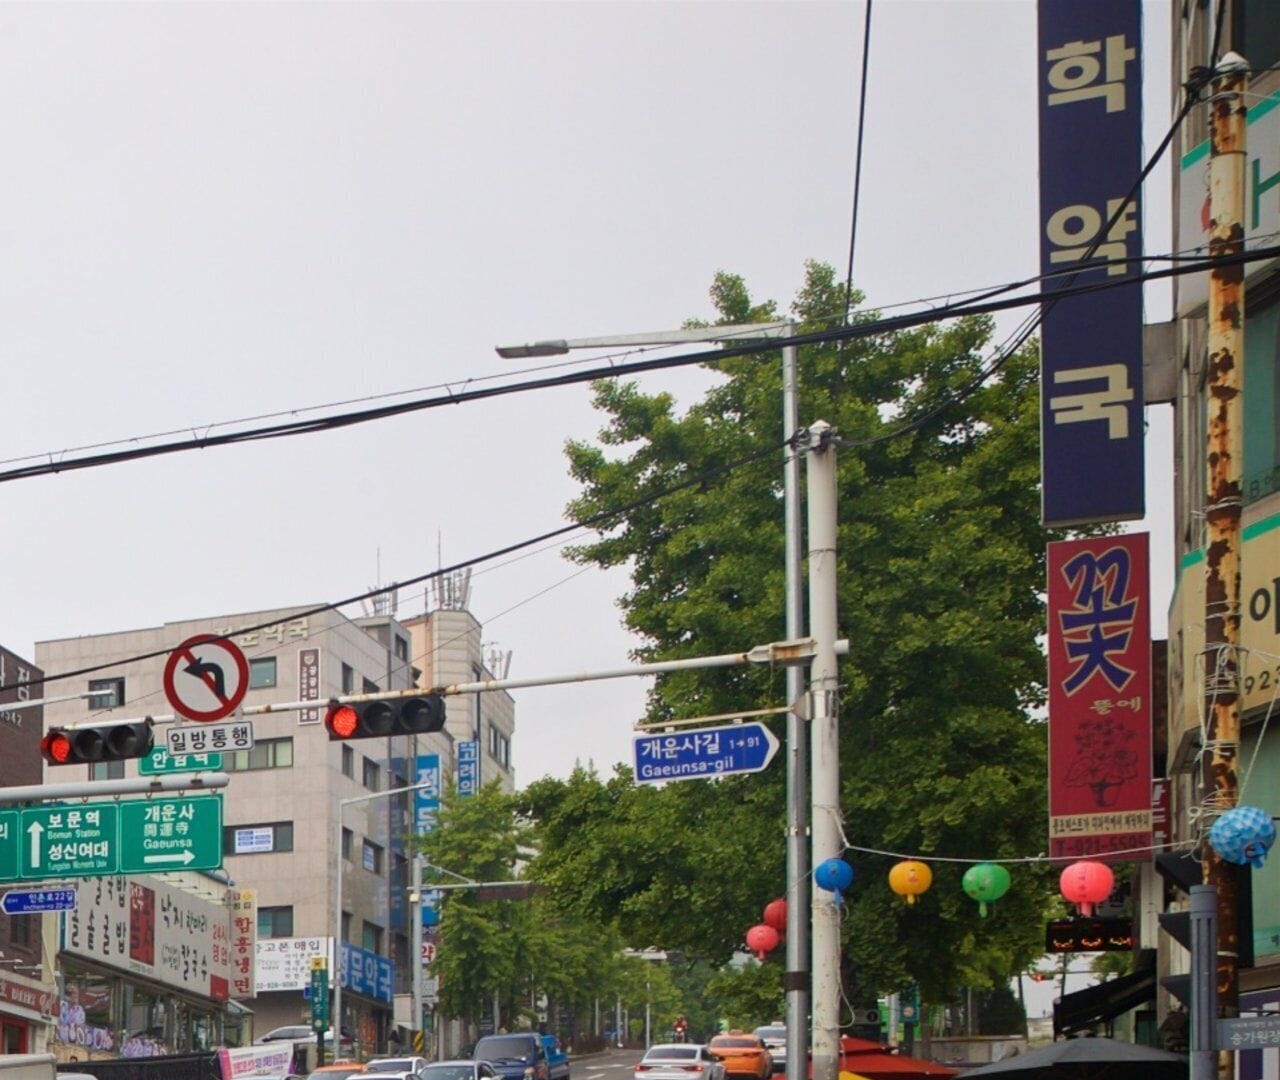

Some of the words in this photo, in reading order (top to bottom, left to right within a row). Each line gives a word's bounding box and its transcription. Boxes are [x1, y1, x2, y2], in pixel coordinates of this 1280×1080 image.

[1058, 543, 1139, 698] 꽃
[171, 729, 249, 757] 일방통행
[642, 732, 720, 760] 개운사길
[729, 739, 735, 749] 1
[747, 736, 760, 748] 91
[641, 757, 734, 778] Gaeunsa-gil
[47, 810, 100, 829] 보문역
[144, 803, 195, 823] 개운사
[48, 840, 109, 861] 성신여대
[143, 838, 192, 850] Gaeunsa
[234, 916, 253, 994] 함흥냉면
